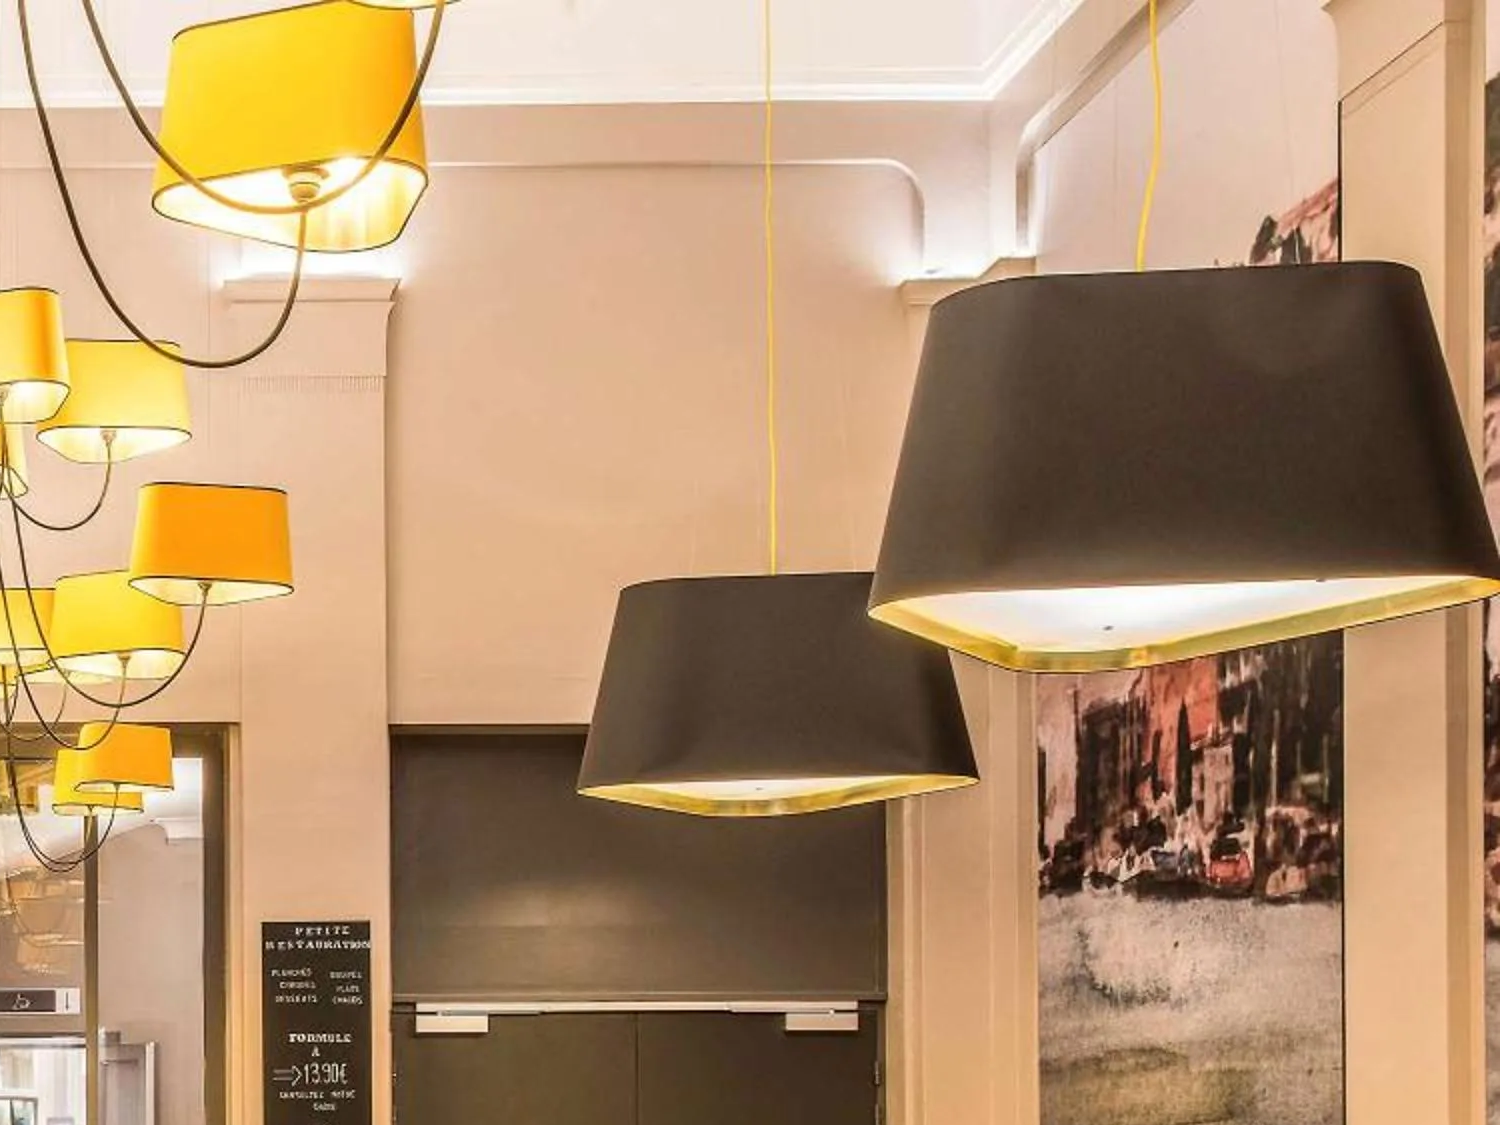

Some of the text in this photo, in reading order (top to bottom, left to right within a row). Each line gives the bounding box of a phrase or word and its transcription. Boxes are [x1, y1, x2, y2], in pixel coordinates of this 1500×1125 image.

[295, 926, 350, 936] PETITE
[265, 940, 371, 950] RESTAURATION
[289, 1033, 352, 1043] FORMULE
